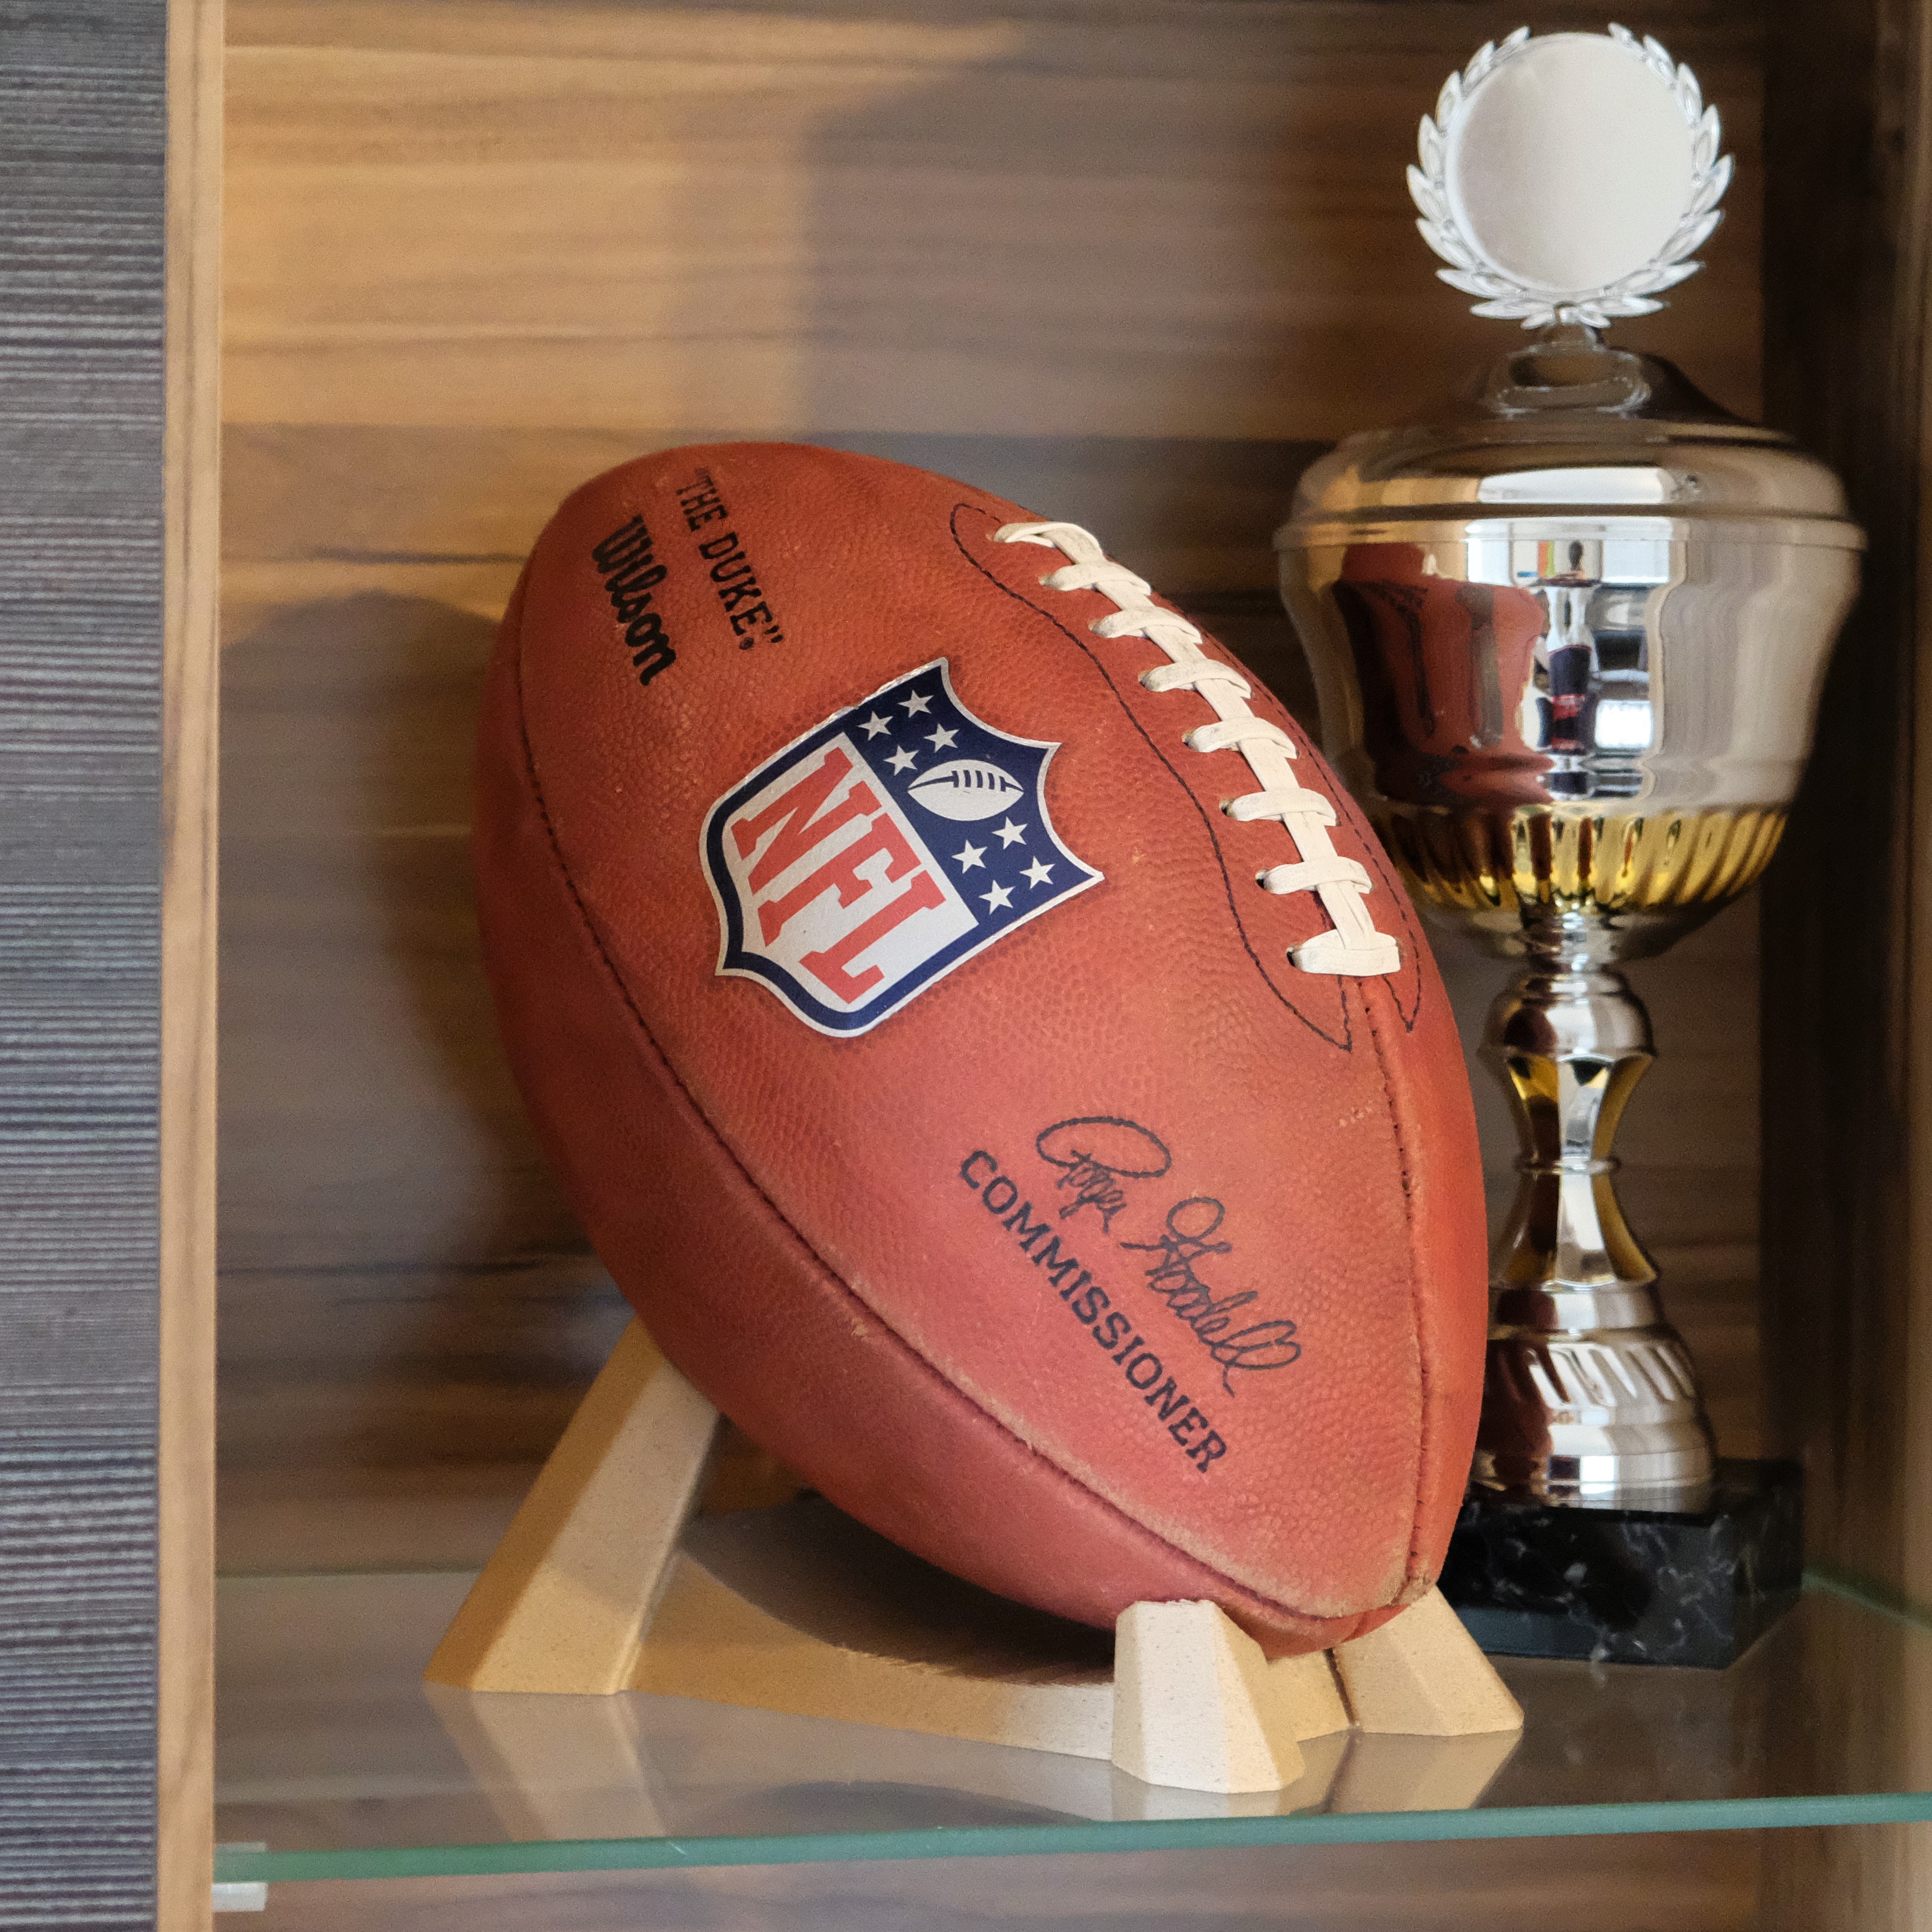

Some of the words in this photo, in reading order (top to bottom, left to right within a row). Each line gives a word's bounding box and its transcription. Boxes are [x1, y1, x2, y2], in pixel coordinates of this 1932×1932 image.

[592, 514, 676, 686] Wilson
[731, 747, 946, 1004] NFL
[959, 1150, 1227, 1472] COMMISSIONER
